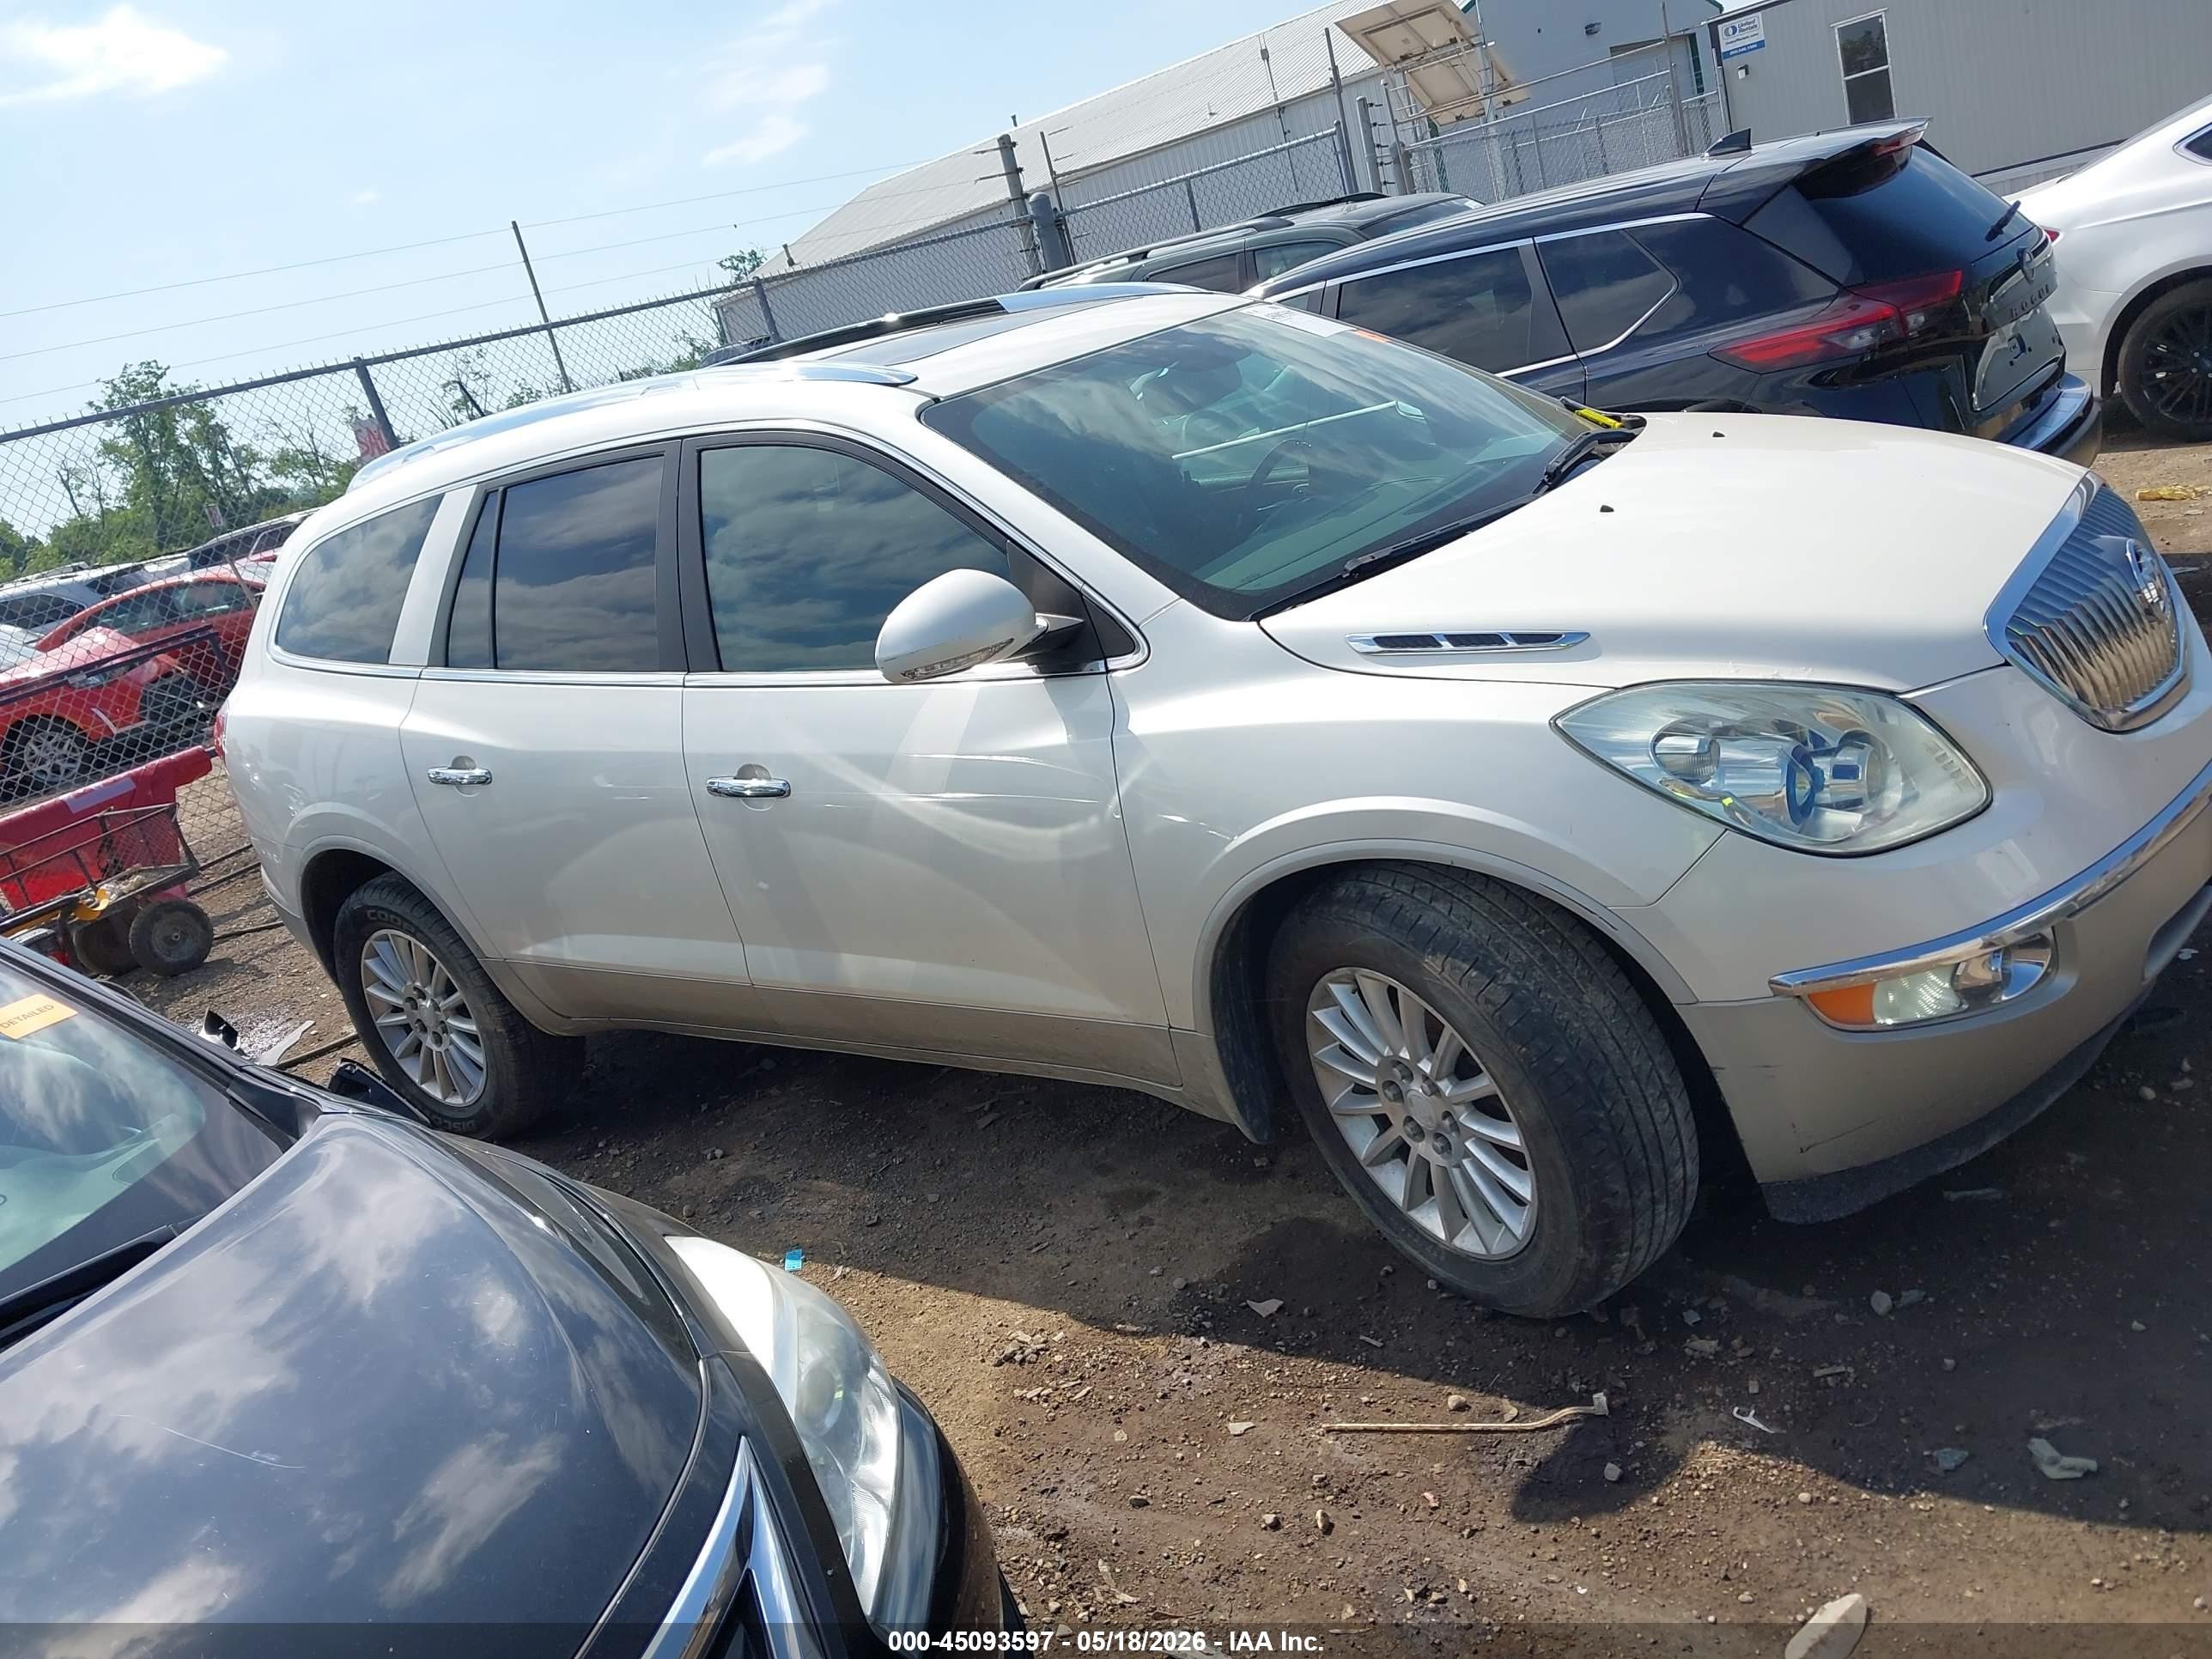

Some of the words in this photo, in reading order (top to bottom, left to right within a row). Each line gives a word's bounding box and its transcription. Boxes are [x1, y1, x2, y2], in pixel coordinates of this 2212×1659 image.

[1738, 18, 1756, 28] United
[1738, 24, 1758, 34] Rentals
[0, 1005, 55, 1029] DETAILED
